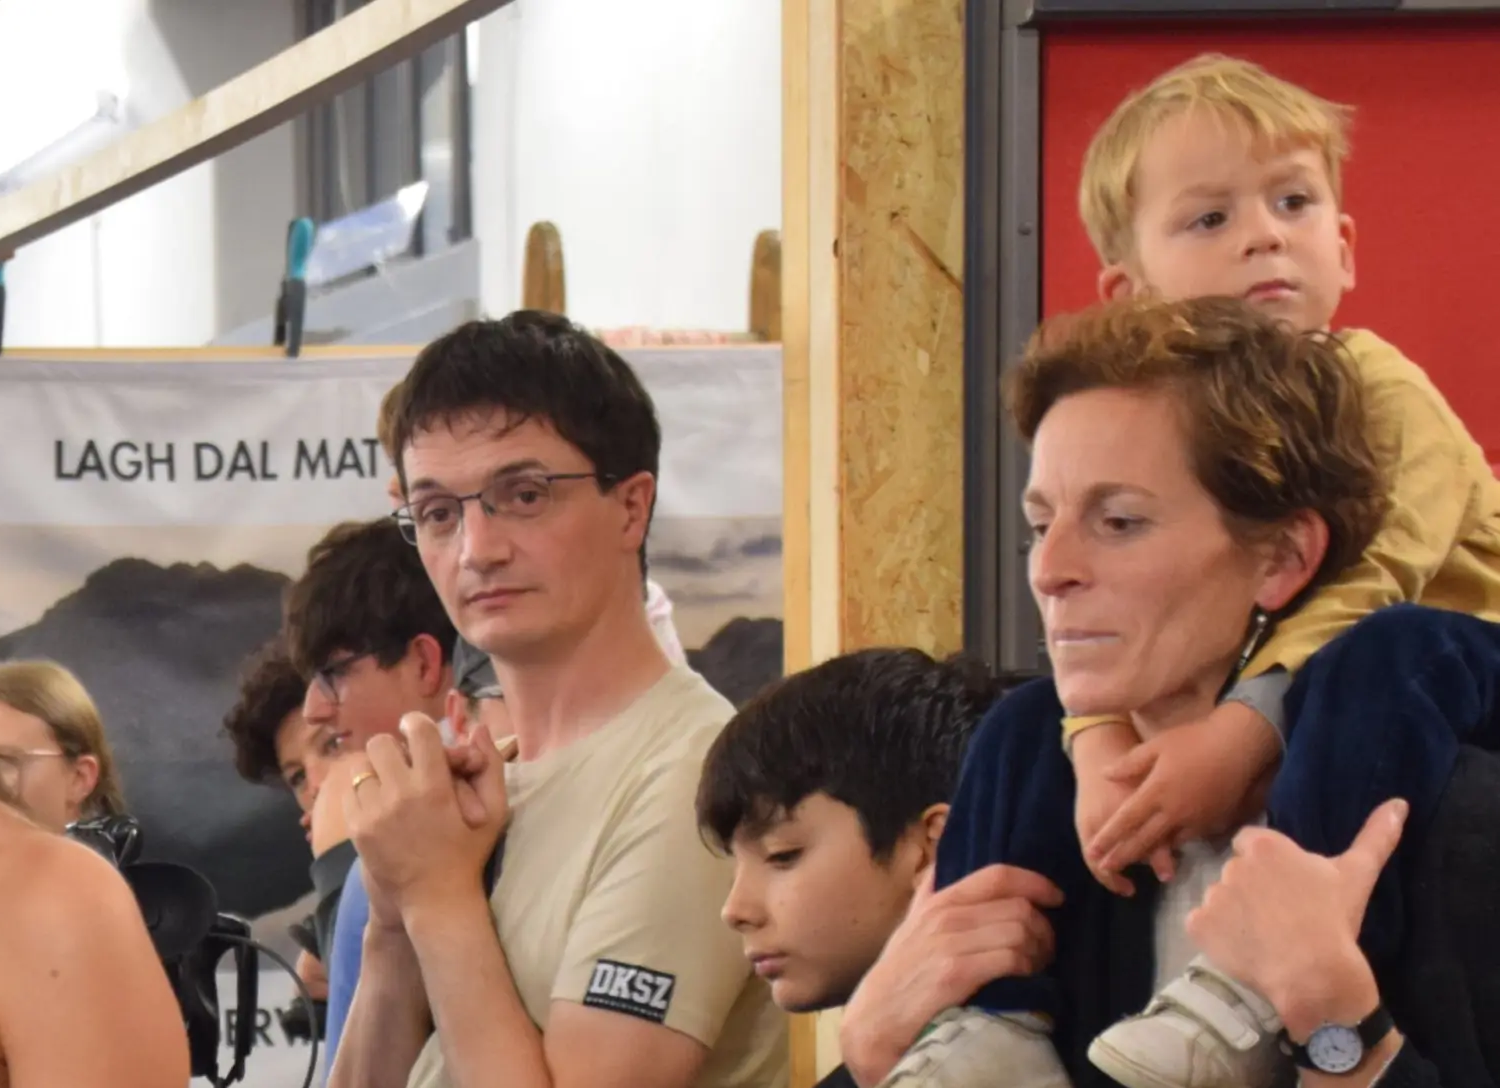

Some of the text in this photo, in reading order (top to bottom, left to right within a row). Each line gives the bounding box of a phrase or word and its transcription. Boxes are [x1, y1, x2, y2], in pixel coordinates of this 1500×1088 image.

[54, 438, 176, 482] LAGH
[193, 440, 278, 482] DAL
[589, 962, 673, 1011] DKSZ
